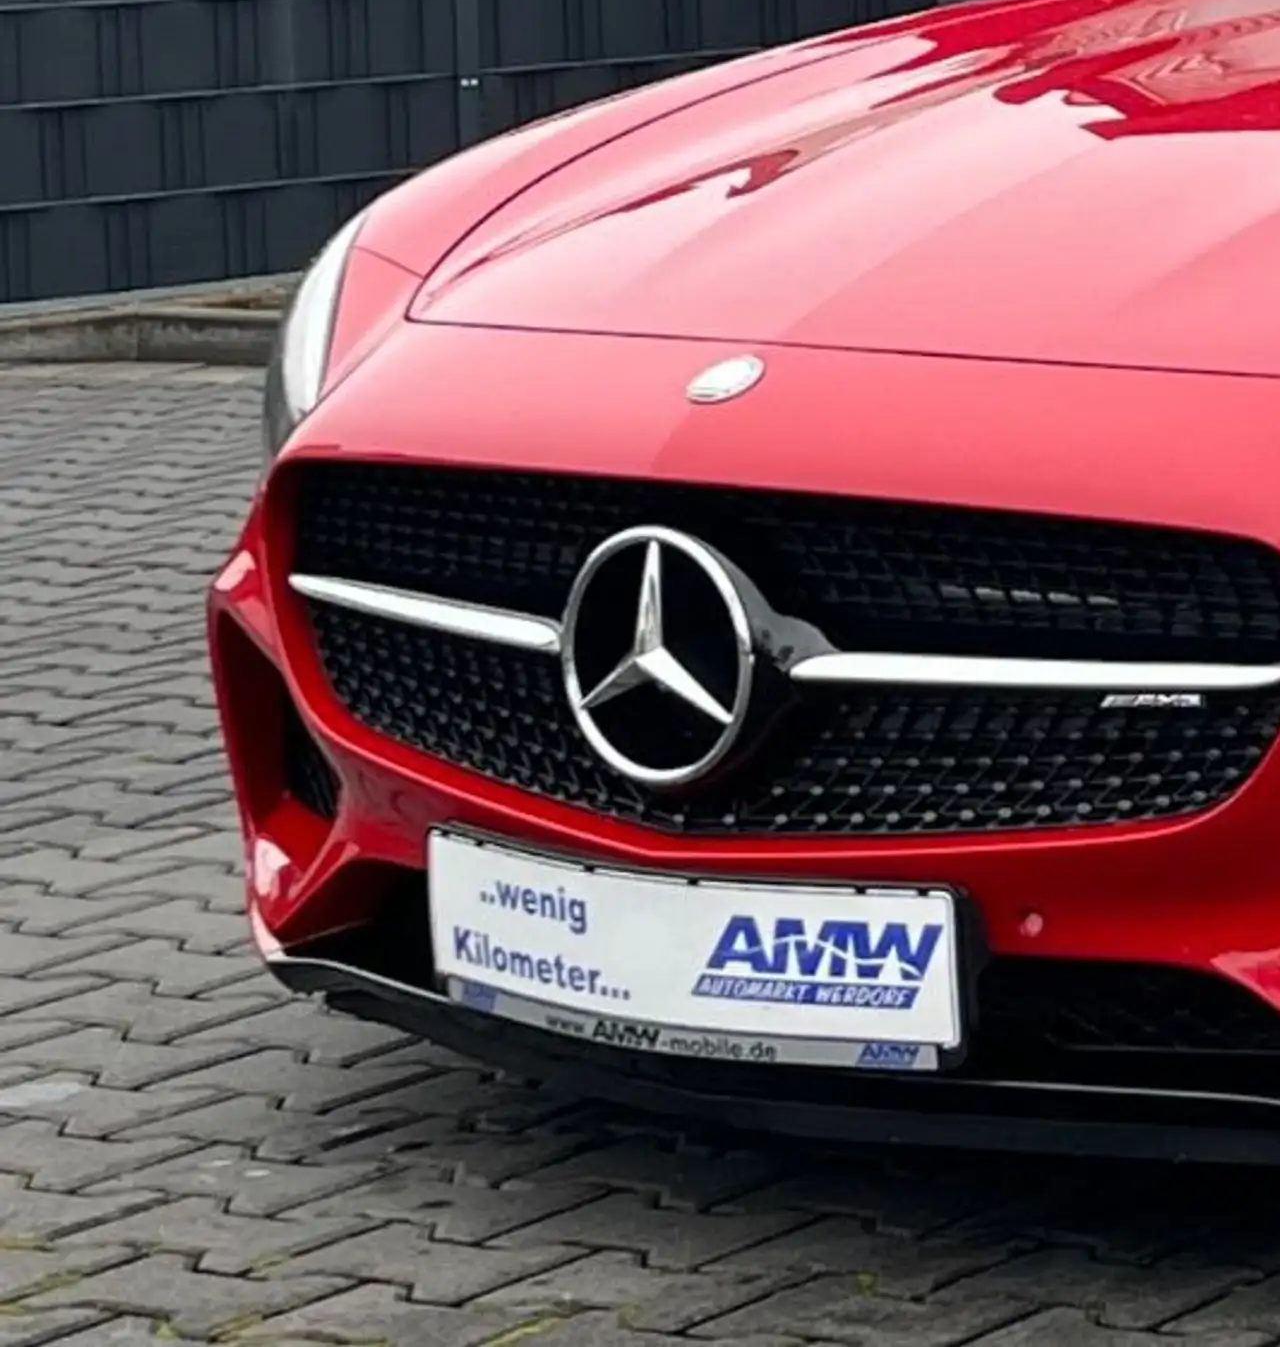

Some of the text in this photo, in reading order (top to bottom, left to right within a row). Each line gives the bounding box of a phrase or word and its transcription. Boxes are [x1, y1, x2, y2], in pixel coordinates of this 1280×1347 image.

[453, 925, 632, 1001] Kilometer...
[706, 914, 944, 981] AMW
[698, 976, 912, 1007] AUTOMARKT WERDORF
